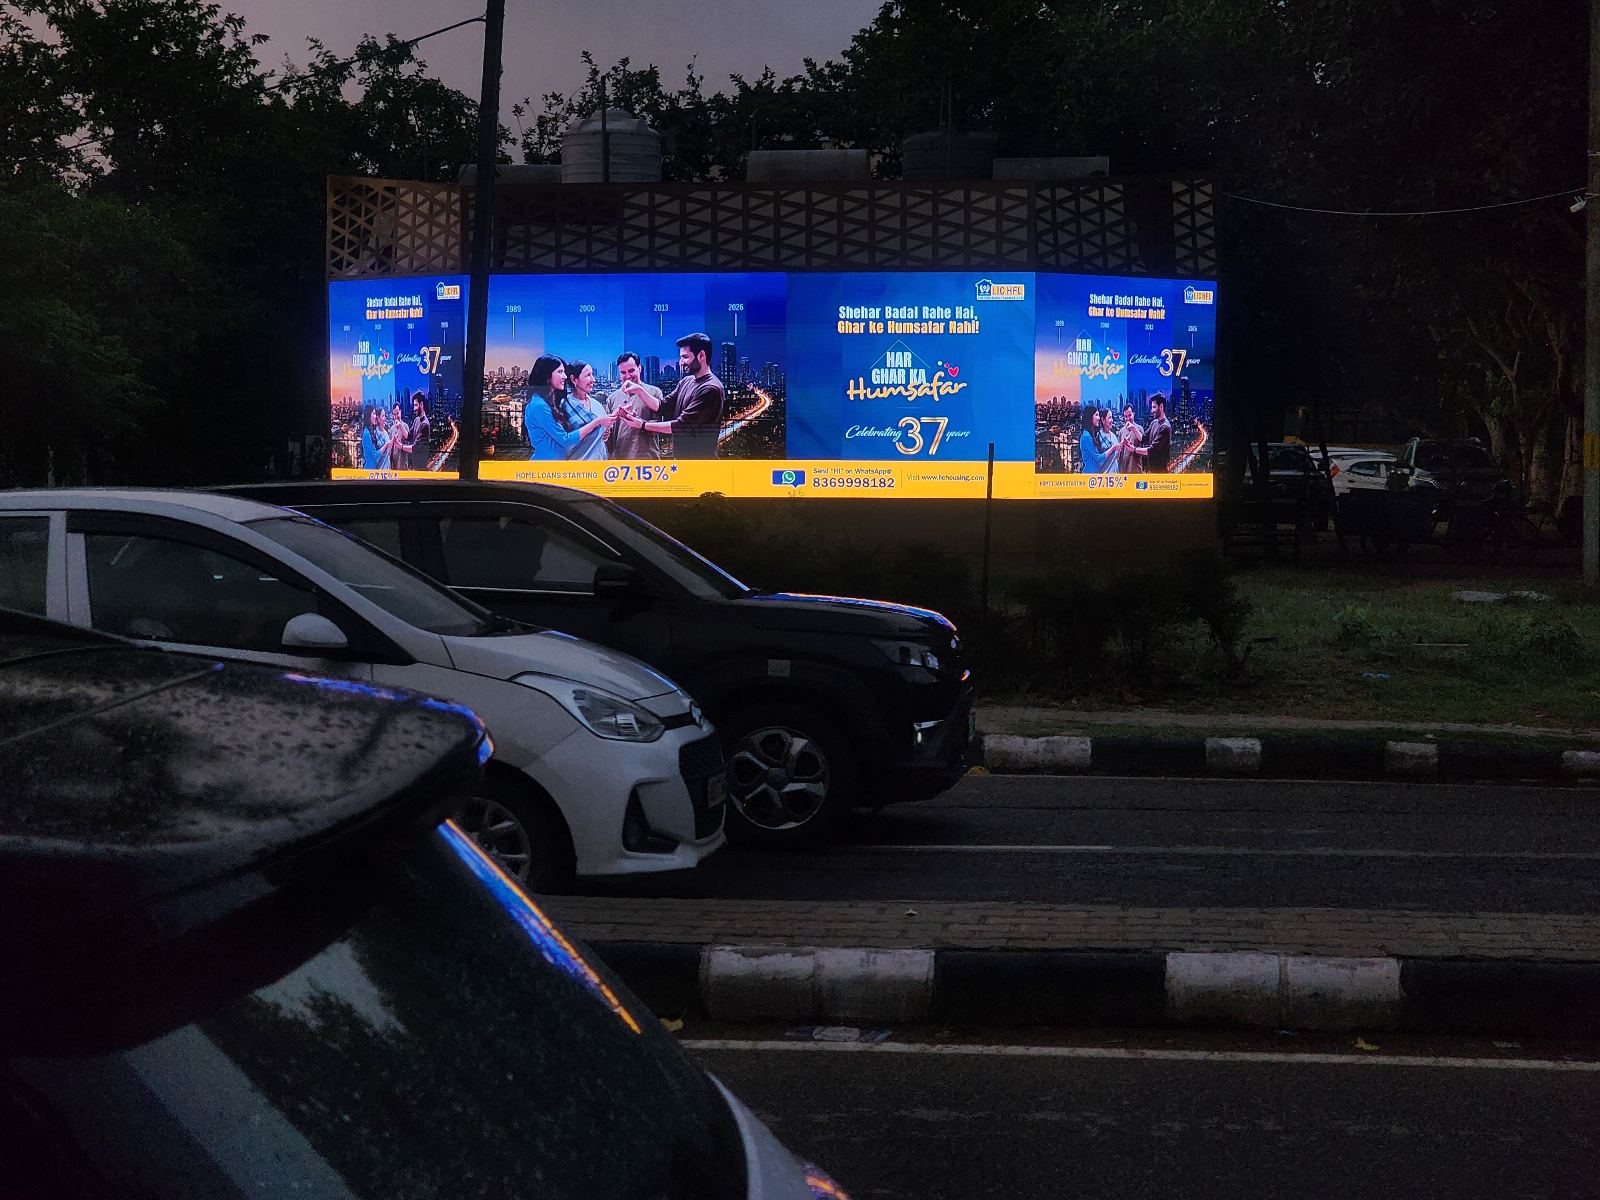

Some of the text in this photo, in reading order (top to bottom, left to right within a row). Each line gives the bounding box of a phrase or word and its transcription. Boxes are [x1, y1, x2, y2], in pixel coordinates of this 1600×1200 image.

[654, 304, 669, 312] 2013
[728, 303, 744, 311] 2026
[838, 306, 978, 320] Shehar Badal Rahe Hai,
[837, 321, 980, 334] Ghar ke Humsafar Nahi!
[358, 341, 370, 354] HAR
[1076, 338, 1092, 351] HAR
[396, 353, 422, 366] Celebrating
[419, 346, 441, 374] 37
[886, 352, 912, 368] HAR
[1068, 352, 1100, 366] GHAR KA
[1130, 354, 1162, 368] Celebrating
[1160, 348, 1186, 376] 37
[344, 356, 393, 380] Humsafar
[1052, 355, 1124, 380] Humsafar
[872, 368, 926, 384] GHAR KA
[846, 371, 968, 402] Humsafar
[846, 416, 971, 455] Celebrating 37 years
[813, 478, 894, 488] 8369998182
